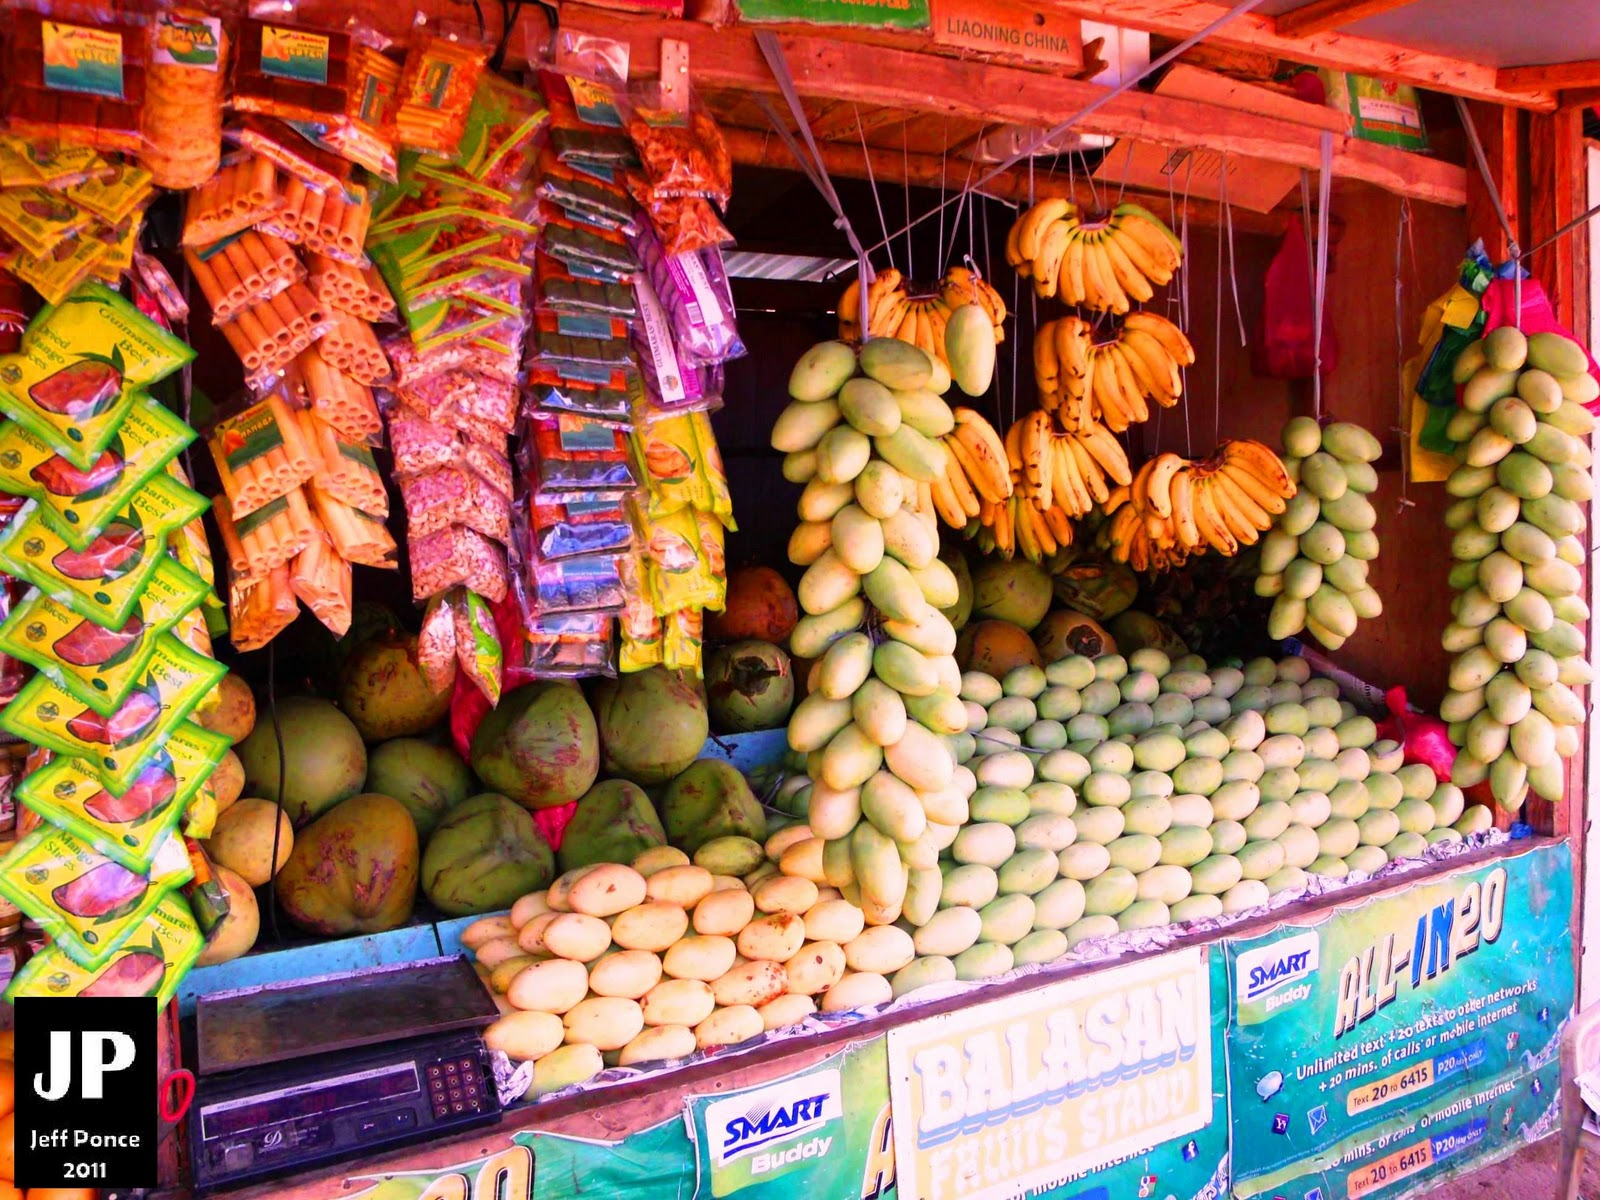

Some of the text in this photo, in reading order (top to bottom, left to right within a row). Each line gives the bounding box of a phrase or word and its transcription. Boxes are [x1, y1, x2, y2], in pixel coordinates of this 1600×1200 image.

[947, 18, 1070, 54] LIAONING CHINA
[641, 302, 653, 322] BEST
[119, 339, 150, 367] Best
[16, 427, 46, 454] Slices
[133, 496, 167, 520] Best
[40, 600, 70, 624] Slices
[152, 662, 183, 690] Best
[45, 840, 76, 871] Slices
[58, 831, 94, 866] Mango
[156, 923, 186, 946] Best
[1249, 950, 1311, 990] SMART
[1266, 982, 1312, 1012] Buddy
[1296, 1044, 1358, 1080] Unlimited
[1398, 1026, 1414, 1041] 20
[1415, 1012, 1444, 1034] texts
[1444, 1009, 1456, 1022] to
[1458, 996, 1486, 1016] other
[1487, 979, 1538, 1005] networks
[1319, 1081, 1327, 1092] +
[1329, 1073, 1342, 1089] 20
[1345, 1061, 1378, 1081] mins.
[1381, 1049, 1392, 1067] of
[1425, 1035, 1436, 1048] or
[1440, 1019, 1475, 1045] mobile
[1477, 1001, 1518, 1028] internet
[914, 973, 1198, 1148] BALASAN
[1353, 1094, 1369, 1107] Text
[1371, 1084, 1388, 1102] 20
[1390, 1083, 1398, 1093] to
[1400, 1067, 1428, 1090] 6415
[1468, 1049, 1483, 1063] ONLY
[724, 1092, 830, 1148] SMART
[1079, 1067, 1192, 1150] STAND
[1467, 1126, 1483, 1140] ONLY
[751, 1136, 833, 1175] Buddy
[1354, 1147, 1427, 1191] Text 20 to 6415
